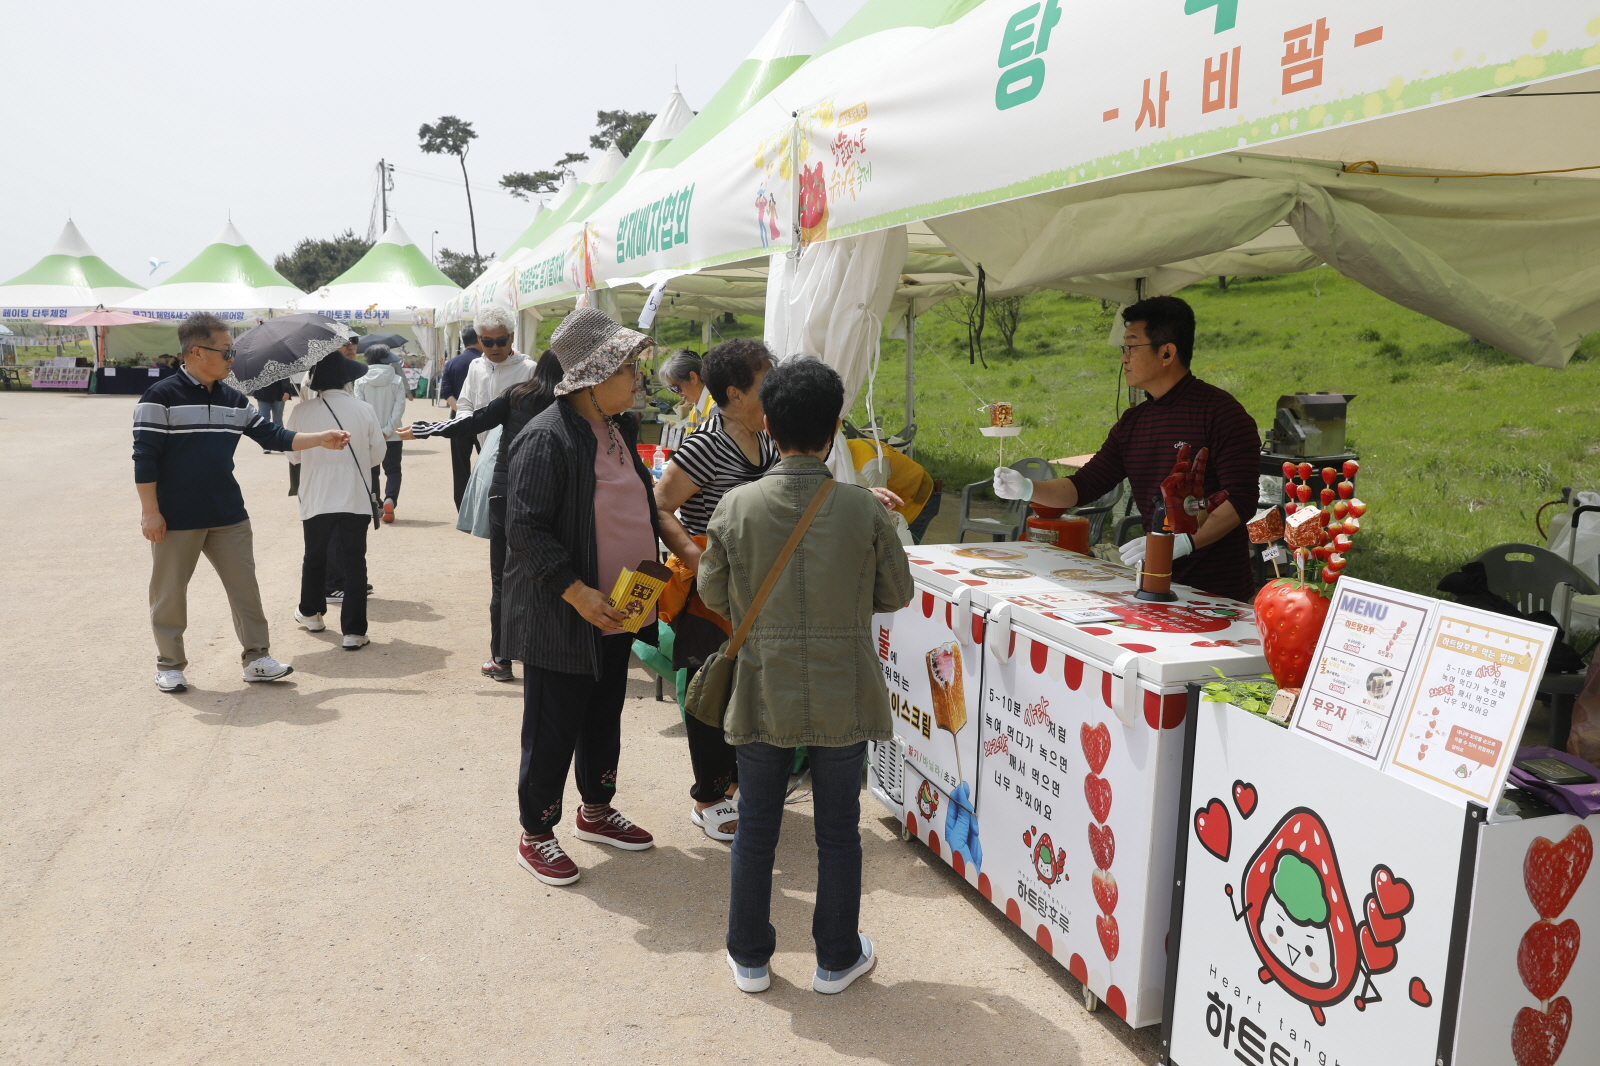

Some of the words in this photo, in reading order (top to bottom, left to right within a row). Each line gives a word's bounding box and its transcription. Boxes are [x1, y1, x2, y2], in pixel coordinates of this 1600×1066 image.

[32, 309, 68, 318] 타투체험
[1340, 595, 1389, 621] MENU
[886, 688, 932, 741] 이스크림
[1007, 725, 1034, 753] 먹다가
[1039, 744, 1067, 774] 녹으면
[994, 770, 1011, 792] 너무
[1015, 784, 1052, 821] 맛있어요
[1031, 768, 1060, 798] 먹으면
[716, 808, 736, 817] FILA
[1209, 963, 1262, 1014] Heart
